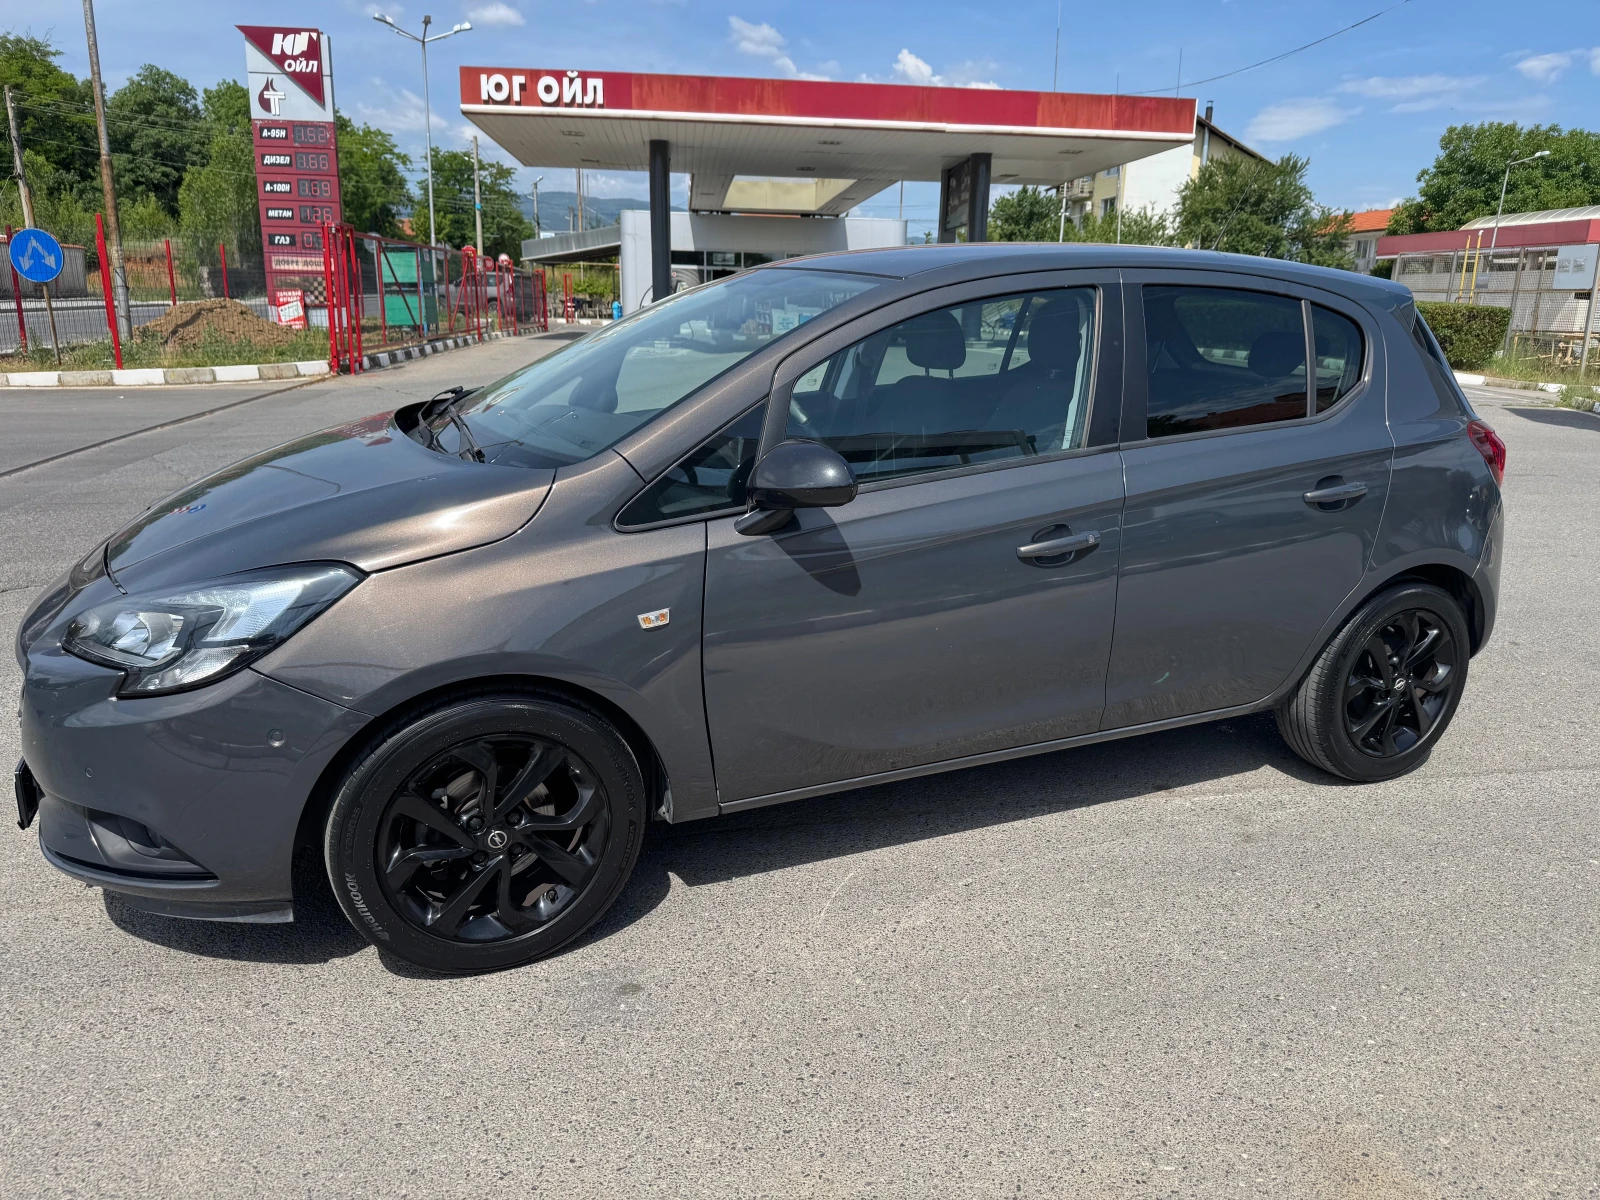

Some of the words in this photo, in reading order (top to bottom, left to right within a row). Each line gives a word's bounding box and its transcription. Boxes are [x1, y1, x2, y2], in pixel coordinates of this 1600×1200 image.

[284, 57, 318, 73] ОЙЛ
[480, 73, 526, 102] ЮГ
[537, 70, 604, 105] ОЙЛ
[263, 155, 290, 165] ДИЗЕЛ
[268, 209, 292, 218] МЕТАН
[274, 236, 290, 245] ГАЗ
